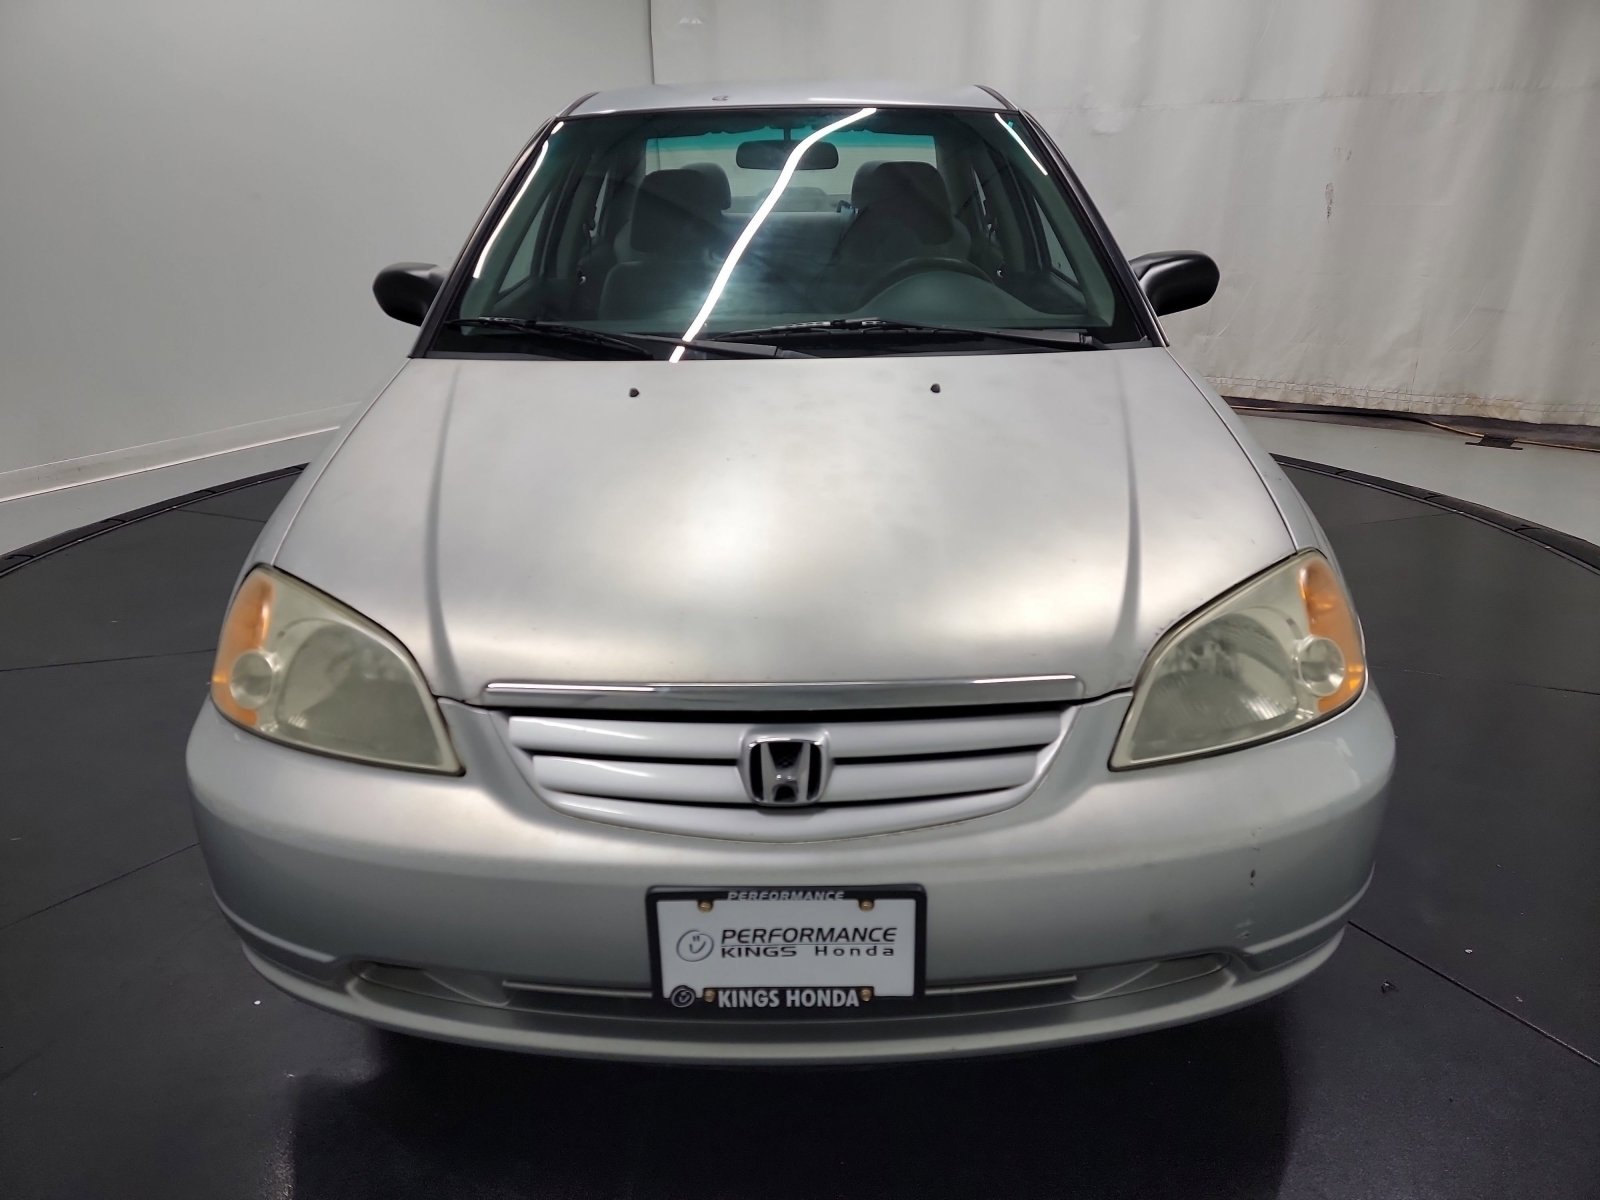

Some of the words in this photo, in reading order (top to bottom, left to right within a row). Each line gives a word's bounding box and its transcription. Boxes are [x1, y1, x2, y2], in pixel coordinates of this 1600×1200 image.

[727, 890, 845, 901] PERFORMANCE
[721, 927, 898, 944] PERFORMANCE
[721, 946, 798, 958] KINGS
[815, 945, 895, 957] Honda
[718, 988, 780, 1008] KINGS
[785, 988, 860, 1008] HONDA
